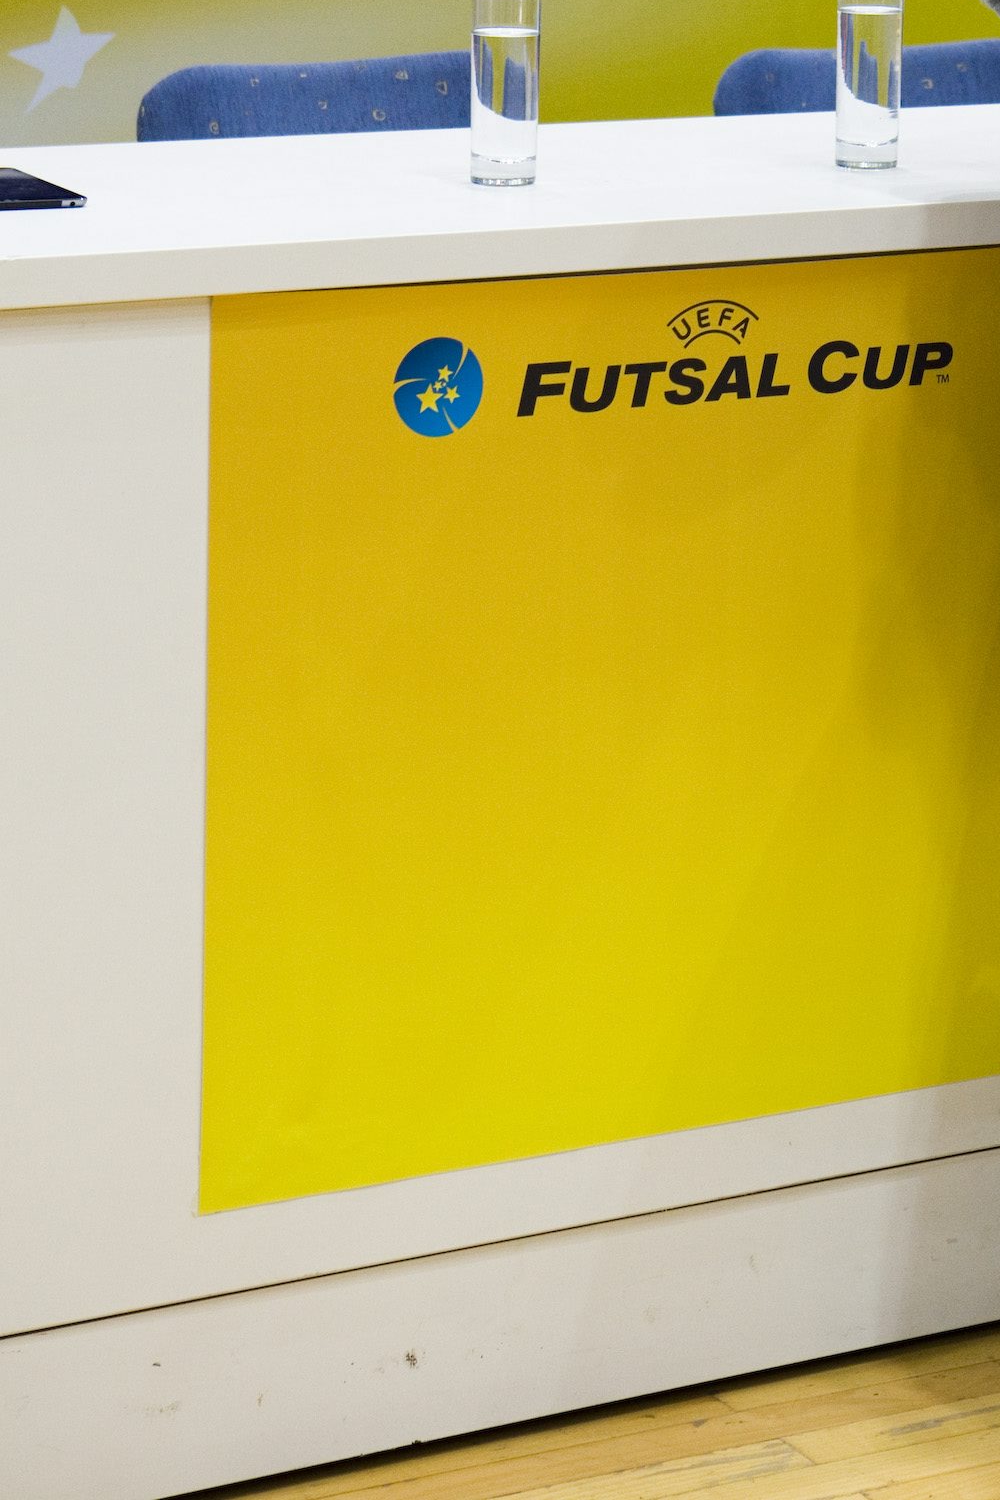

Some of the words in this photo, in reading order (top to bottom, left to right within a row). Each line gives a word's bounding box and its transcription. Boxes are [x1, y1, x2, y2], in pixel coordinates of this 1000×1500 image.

[672, 307, 752, 341] UEFA
[516, 353, 791, 417] FUTSAL
[806, 340, 954, 394] CUP
